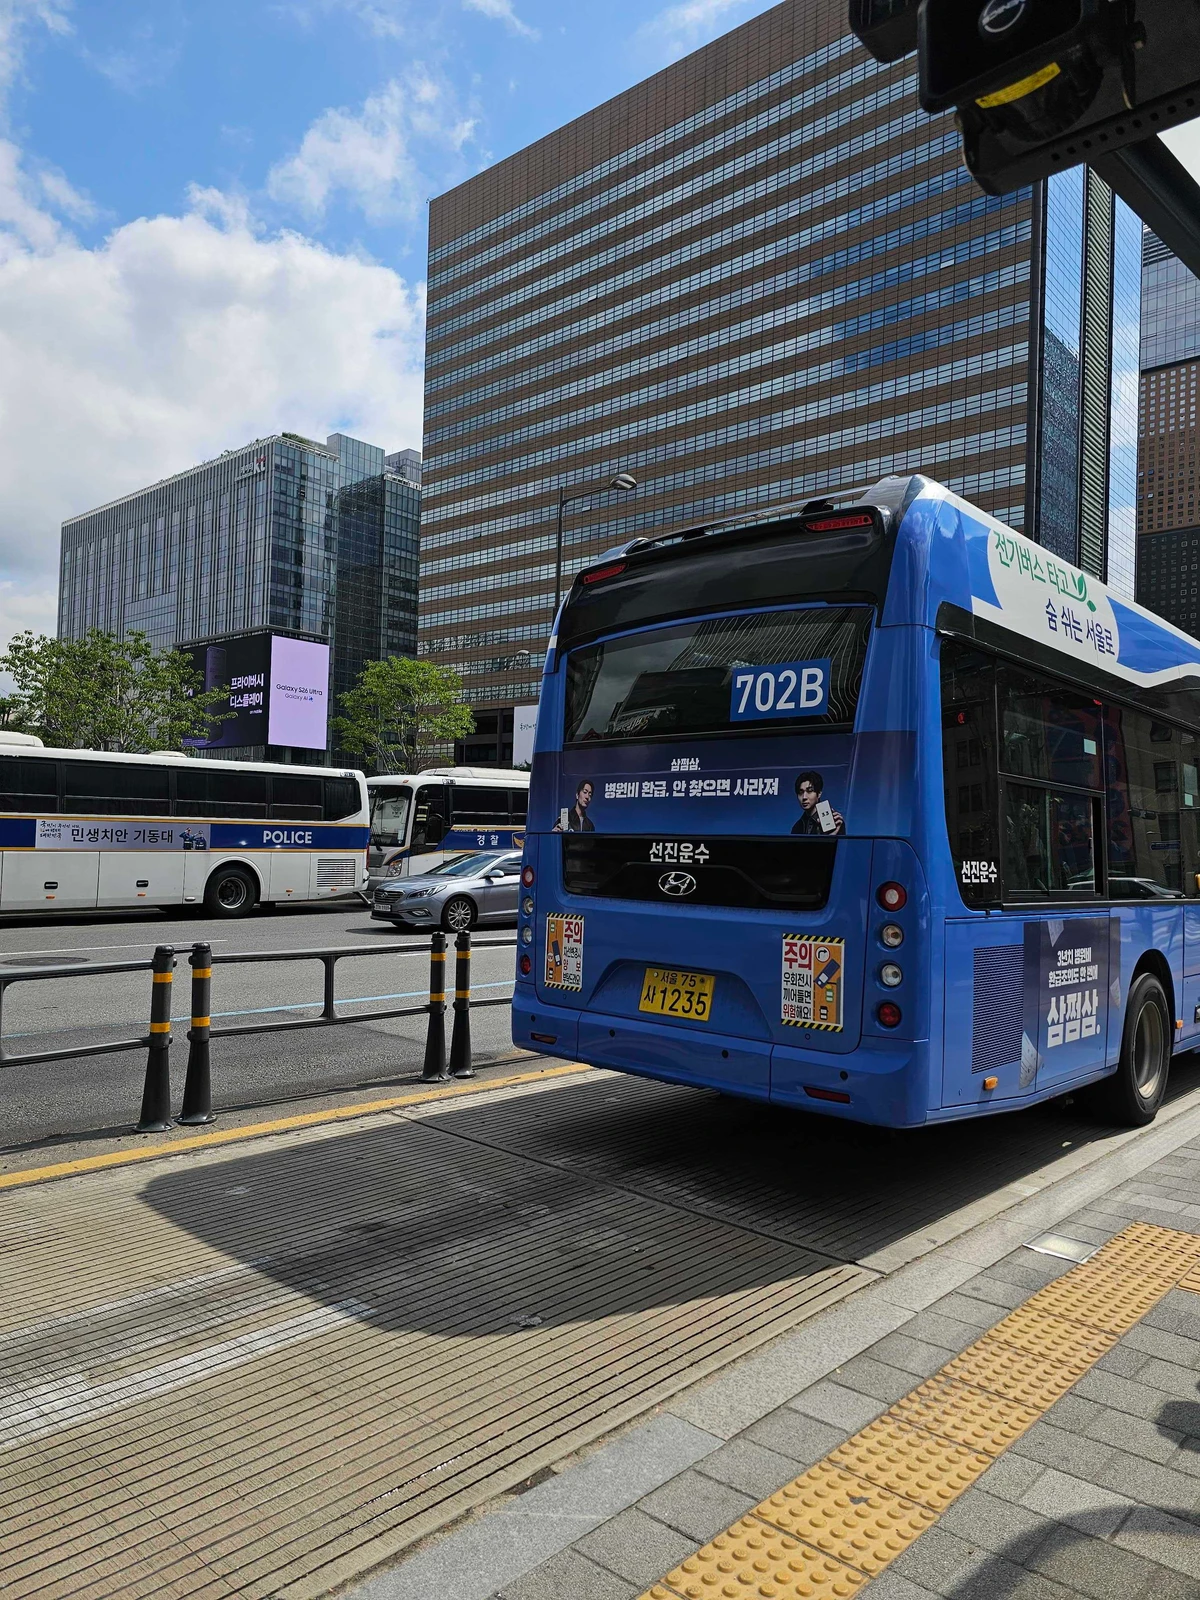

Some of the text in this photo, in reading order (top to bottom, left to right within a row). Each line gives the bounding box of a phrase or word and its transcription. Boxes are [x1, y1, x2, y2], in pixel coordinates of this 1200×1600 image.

[993, 530, 1046, 584] 전기버스
[1045, 598, 1115, 656] 숨 쉬는 서울로
[230, 673, 264, 690] 프라이버시
[276, 683, 323, 696] Galaxy S26 Ultra
[736, 667, 824, 713] 702B
[230, 692, 263, 708] 디스플레이
[604, 777, 779, 799] 병원비 환급, 안 찾으면 사라져
[71, 827, 173, 844] 민생치안 기동대
[263, 830, 312, 843] POLICE
[649, 842, 709, 864] 선진운수
[961, 860, 997, 883] 선진운수
[564, 920, 582, 944] 주의
[783, 941, 812, 970] 주의
[1057, 947, 1091, 967] 3년치 병원비
[660, 971, 697, 988] 서울 75
[783, 971, 812, 988] 우회전시
[783, 988, 811, 1004] 끼어들면
[783, 1003, 811, 1020] 위험해요!
[1047, 988, 1100, 1048] 삼쩜삼.
